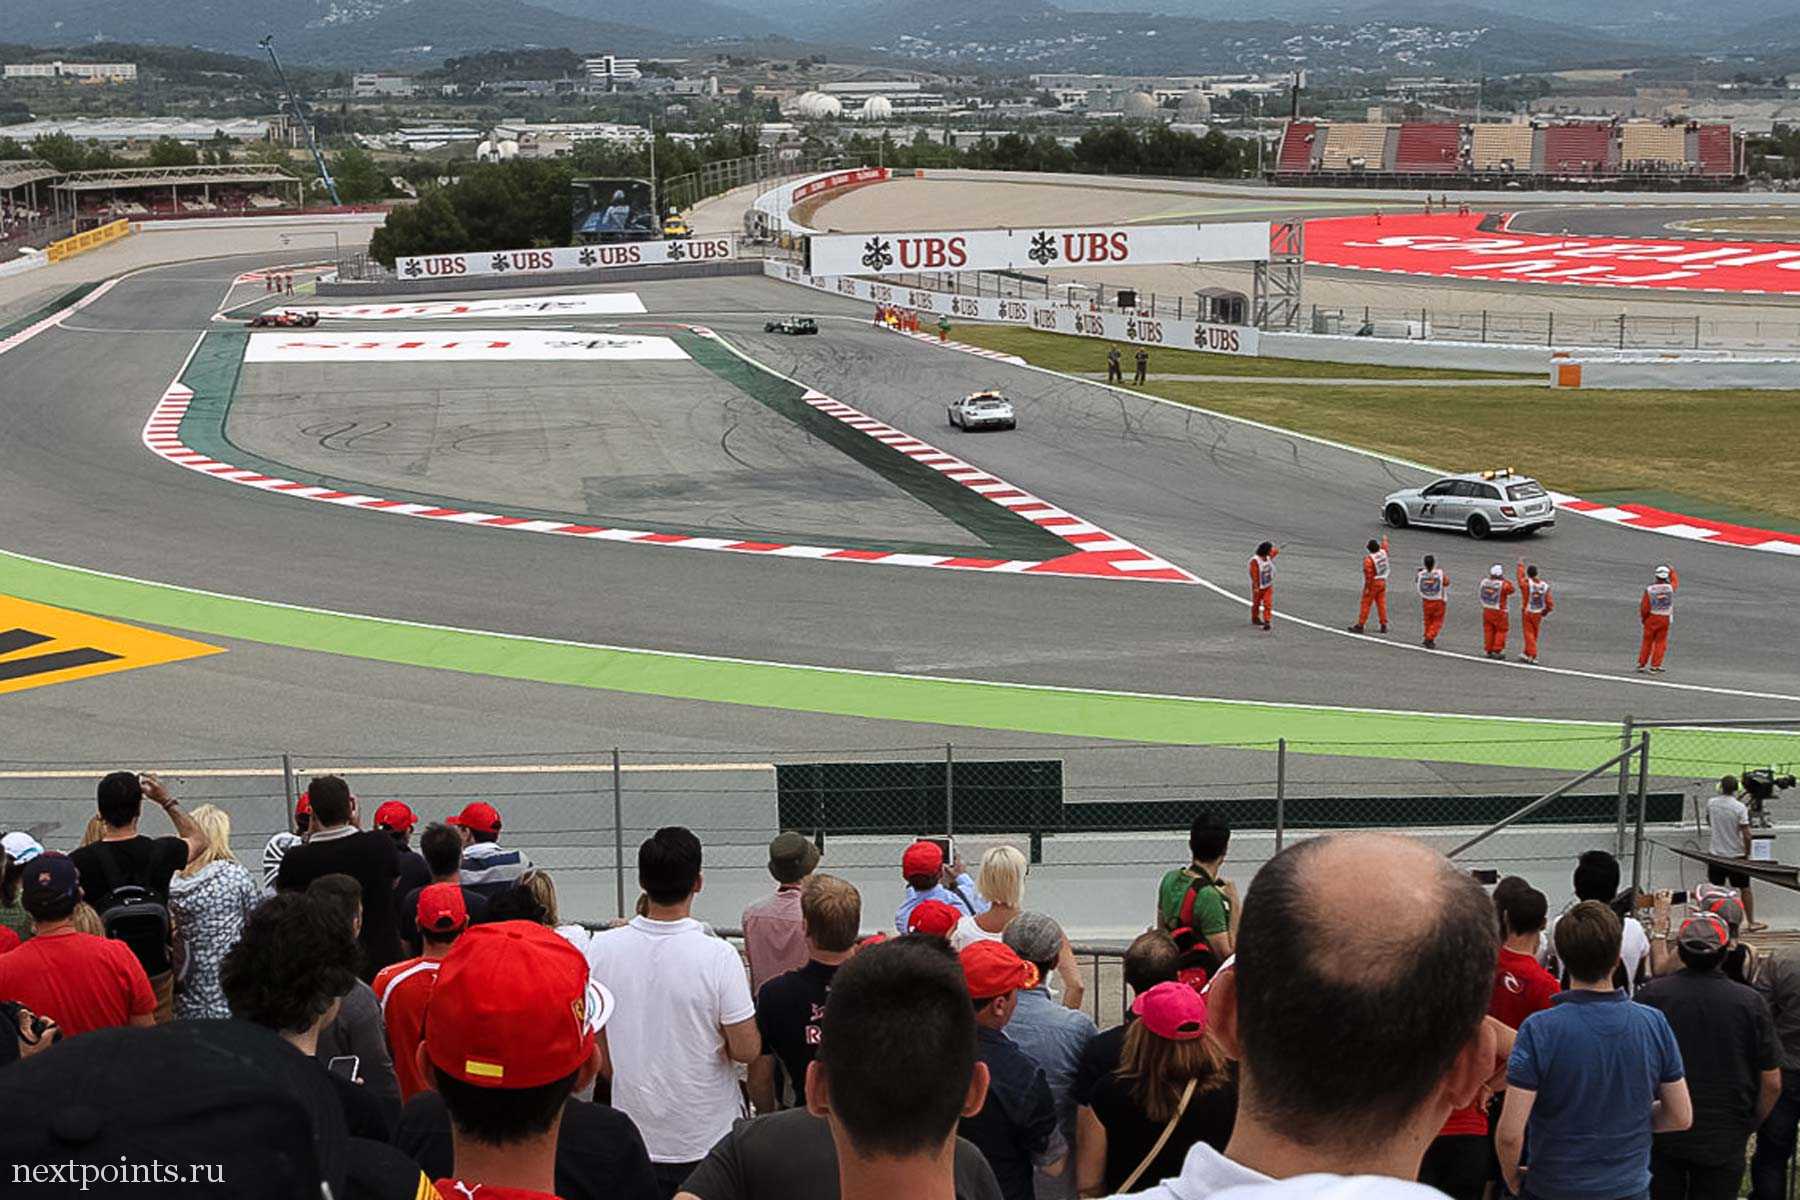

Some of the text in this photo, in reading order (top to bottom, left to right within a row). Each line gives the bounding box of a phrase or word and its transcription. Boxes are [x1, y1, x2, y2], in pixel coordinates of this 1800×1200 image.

[600, 245, 641, 264] UBS
[688, 240, 729, 259] UBS
[897, 237, 968, 268] UBS
[1062, 232, 1129, 262] UBS
[424, 256, 466, 275] UBS
[511, 251, 553, 270] UBS
[960, 298, 979, 317] UBS
[1007, 301, 1028, 320] UBS
[1039, 309, 1056, 329] UBS
[1082, 314, 1105, 336] UBS
[1137, 320, 1164, 343] UBS
[1208, 328, 1240, 352] UBS
